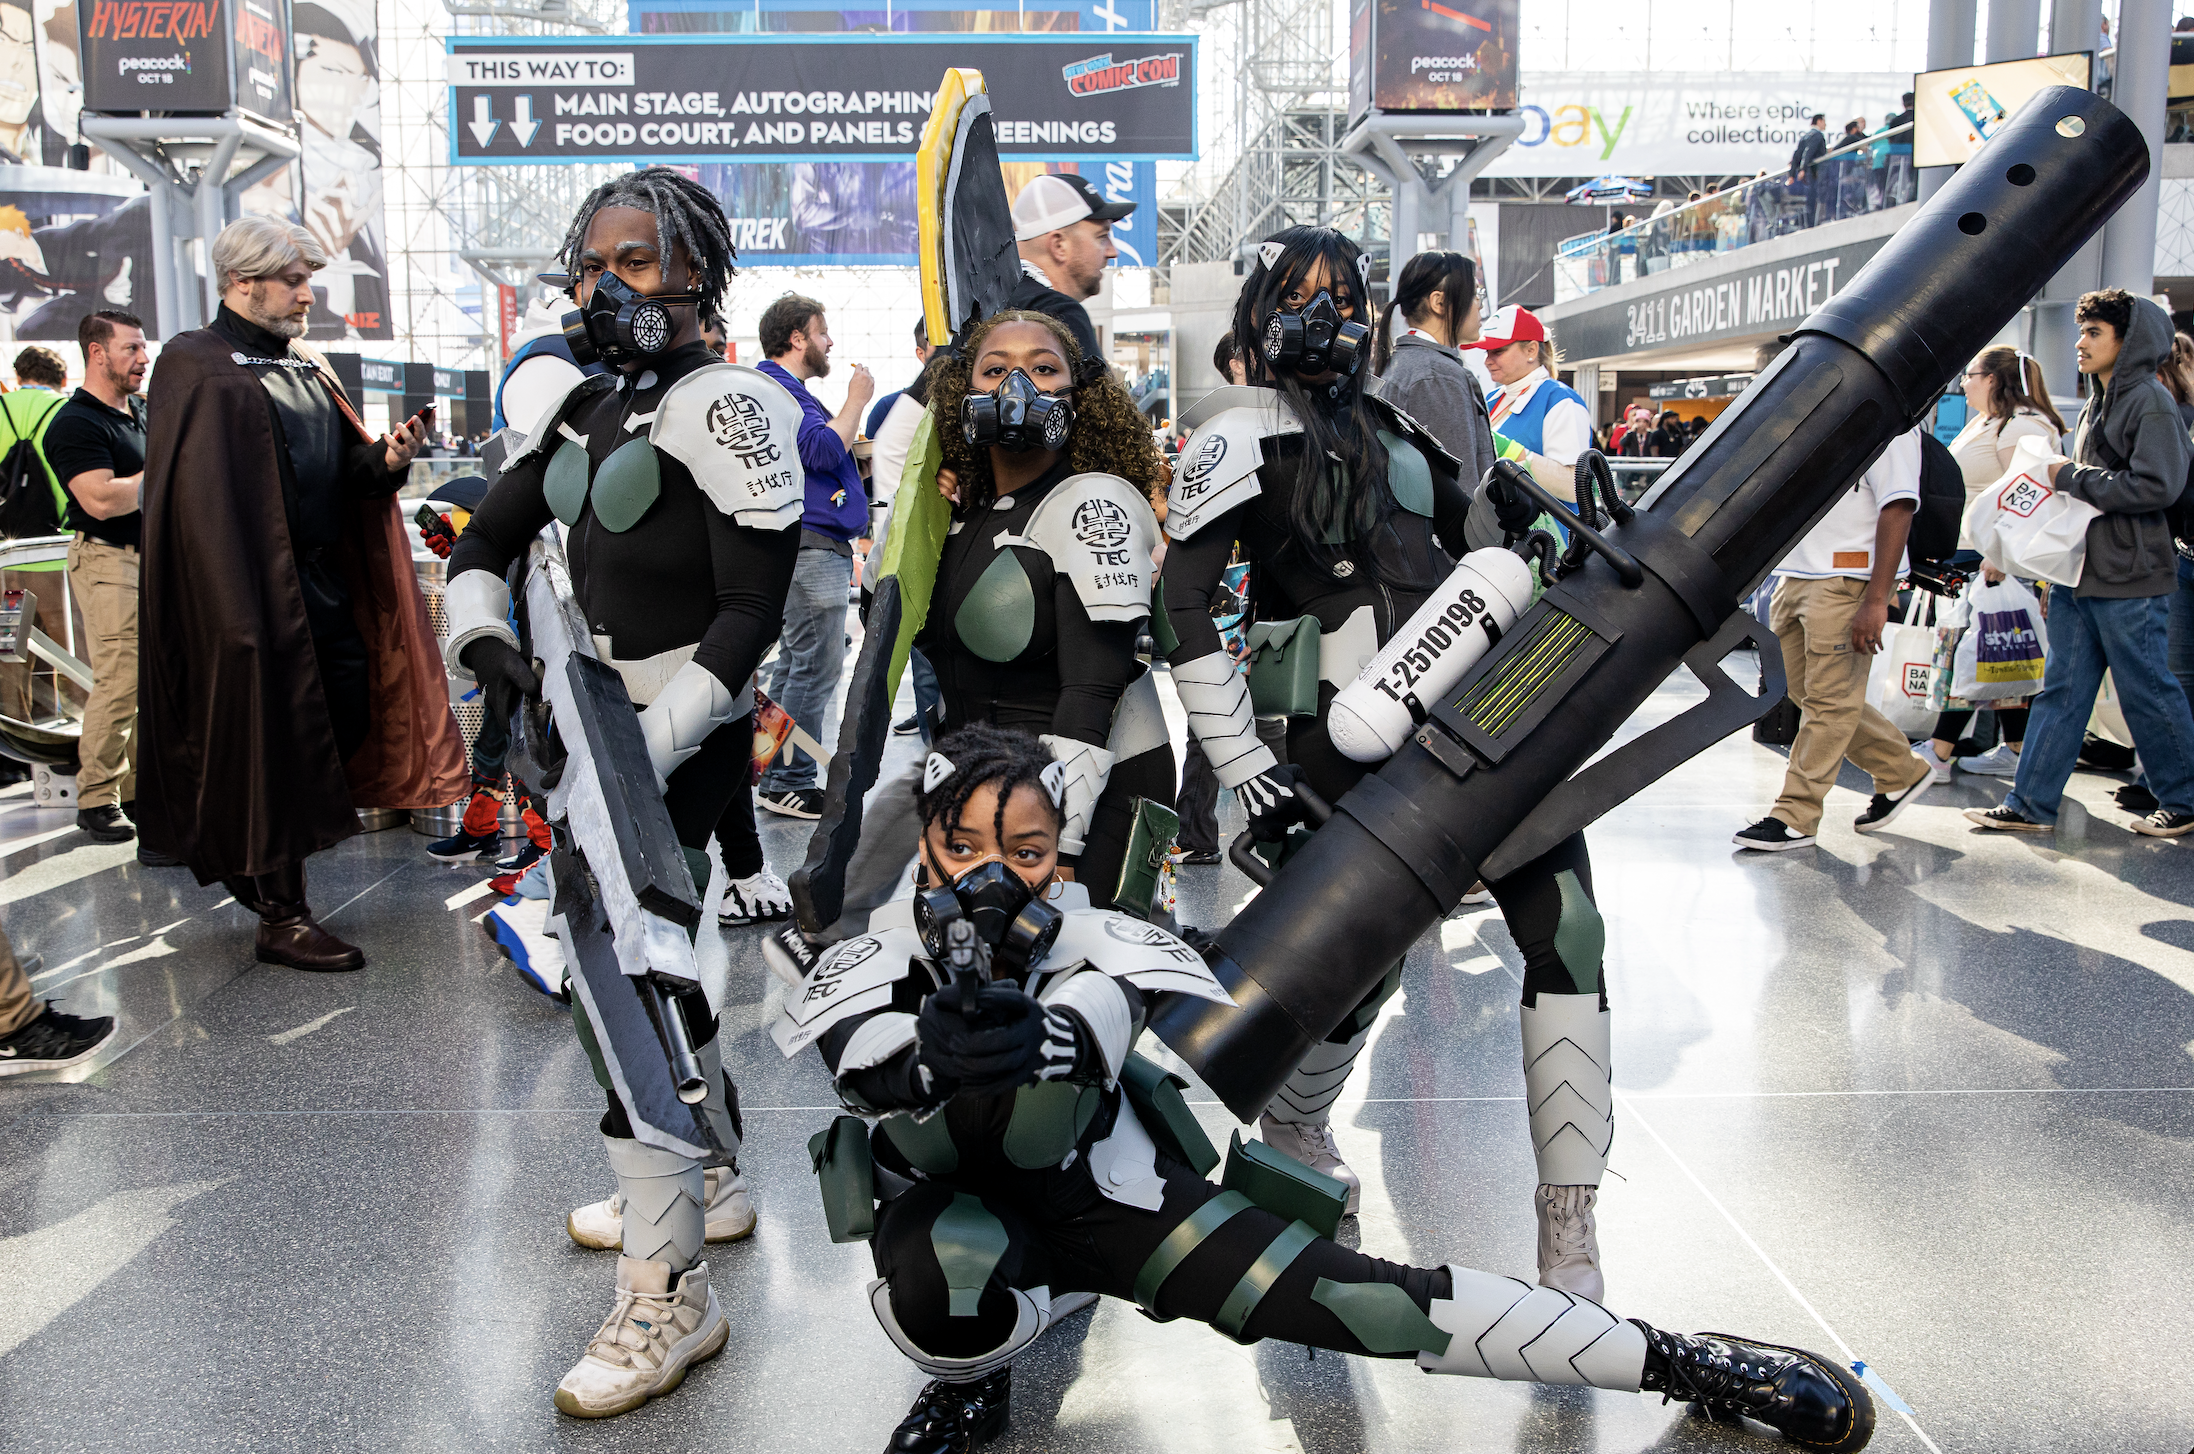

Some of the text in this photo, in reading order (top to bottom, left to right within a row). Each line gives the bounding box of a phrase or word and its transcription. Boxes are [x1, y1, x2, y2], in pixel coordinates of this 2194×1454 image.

[88, 0, 219, 46] HYSTERIA!
[118, 53, 187, 76] peacock
[466, 61, 625, 79] THIS WAY TO:
[1411, 52, 1476, 74] peacock
[137, 73, 160, 84] OCT
[1071, 57, 1177, 93] COMIC CON
[1428, 71, 1463, 82] OCT 18
[554, 92, 629, 116] MAIN
[633, 91, 726, 118] STAGE,
[1687, 101, 1812, 123] Where epic
[556, 122, 637, 146] FOOD
[640, 122, 739, 148] COURT,
[743, 121, 805, 144] AND
[810, 121, 914, 144] PANELS
[994, 120, 1117, 143] EENINGS
[728, 217, 788, 250] TREK
[1626, 257, 1840, 347] 3411 GARDEN MARKET
[344, 312, 381, 329] VIZ
[734, 443, 782, 469] TEC
[1181, 478, 1211, 500] TEC
[1090, 549, 1131, 565] TEC
[1374, 589, 1486, 702] T-2510198
[802, 979, 842, 1004] TEC
